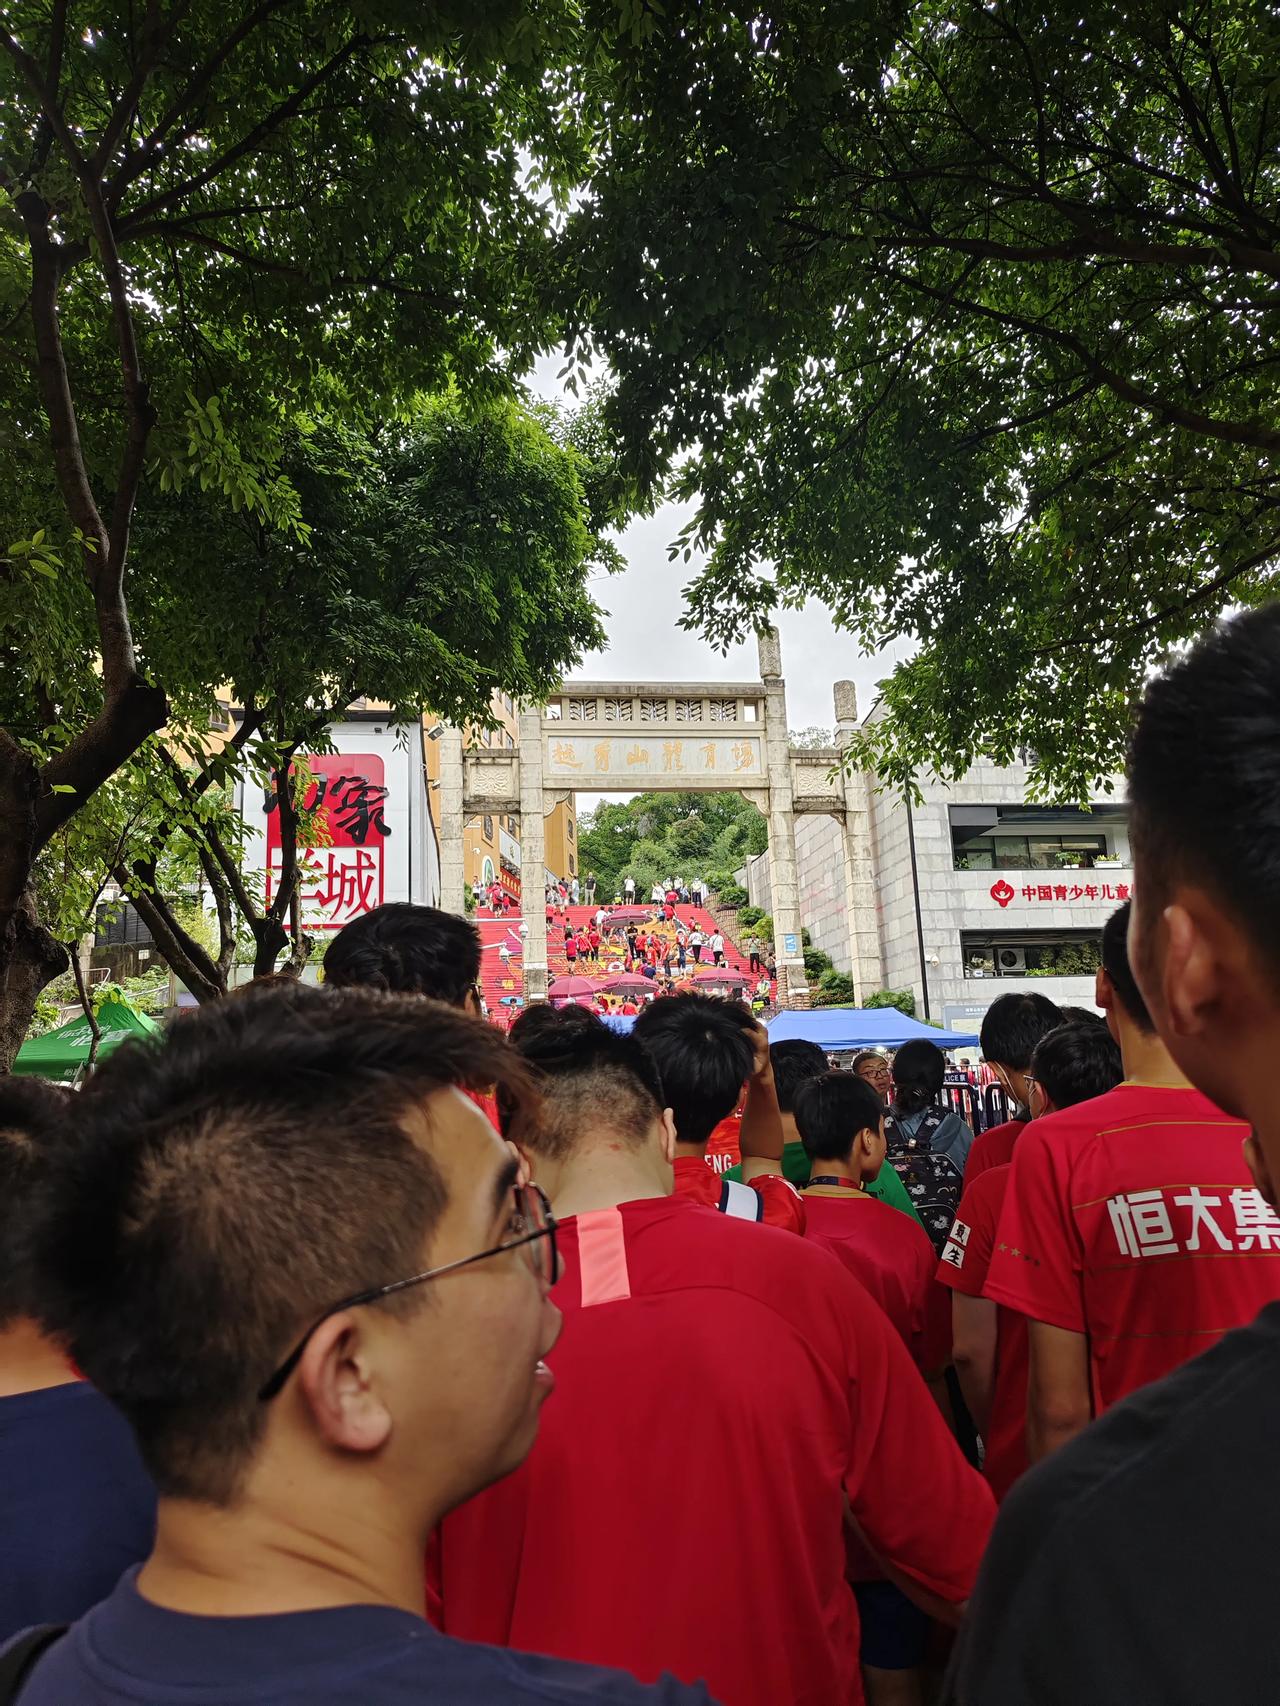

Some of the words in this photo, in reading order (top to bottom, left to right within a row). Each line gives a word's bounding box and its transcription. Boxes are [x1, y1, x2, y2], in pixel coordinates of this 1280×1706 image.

[1022, 884, 1136, 901] 中国青少年儿童
[1107, 1187, 1280, 1258] 恒大集
